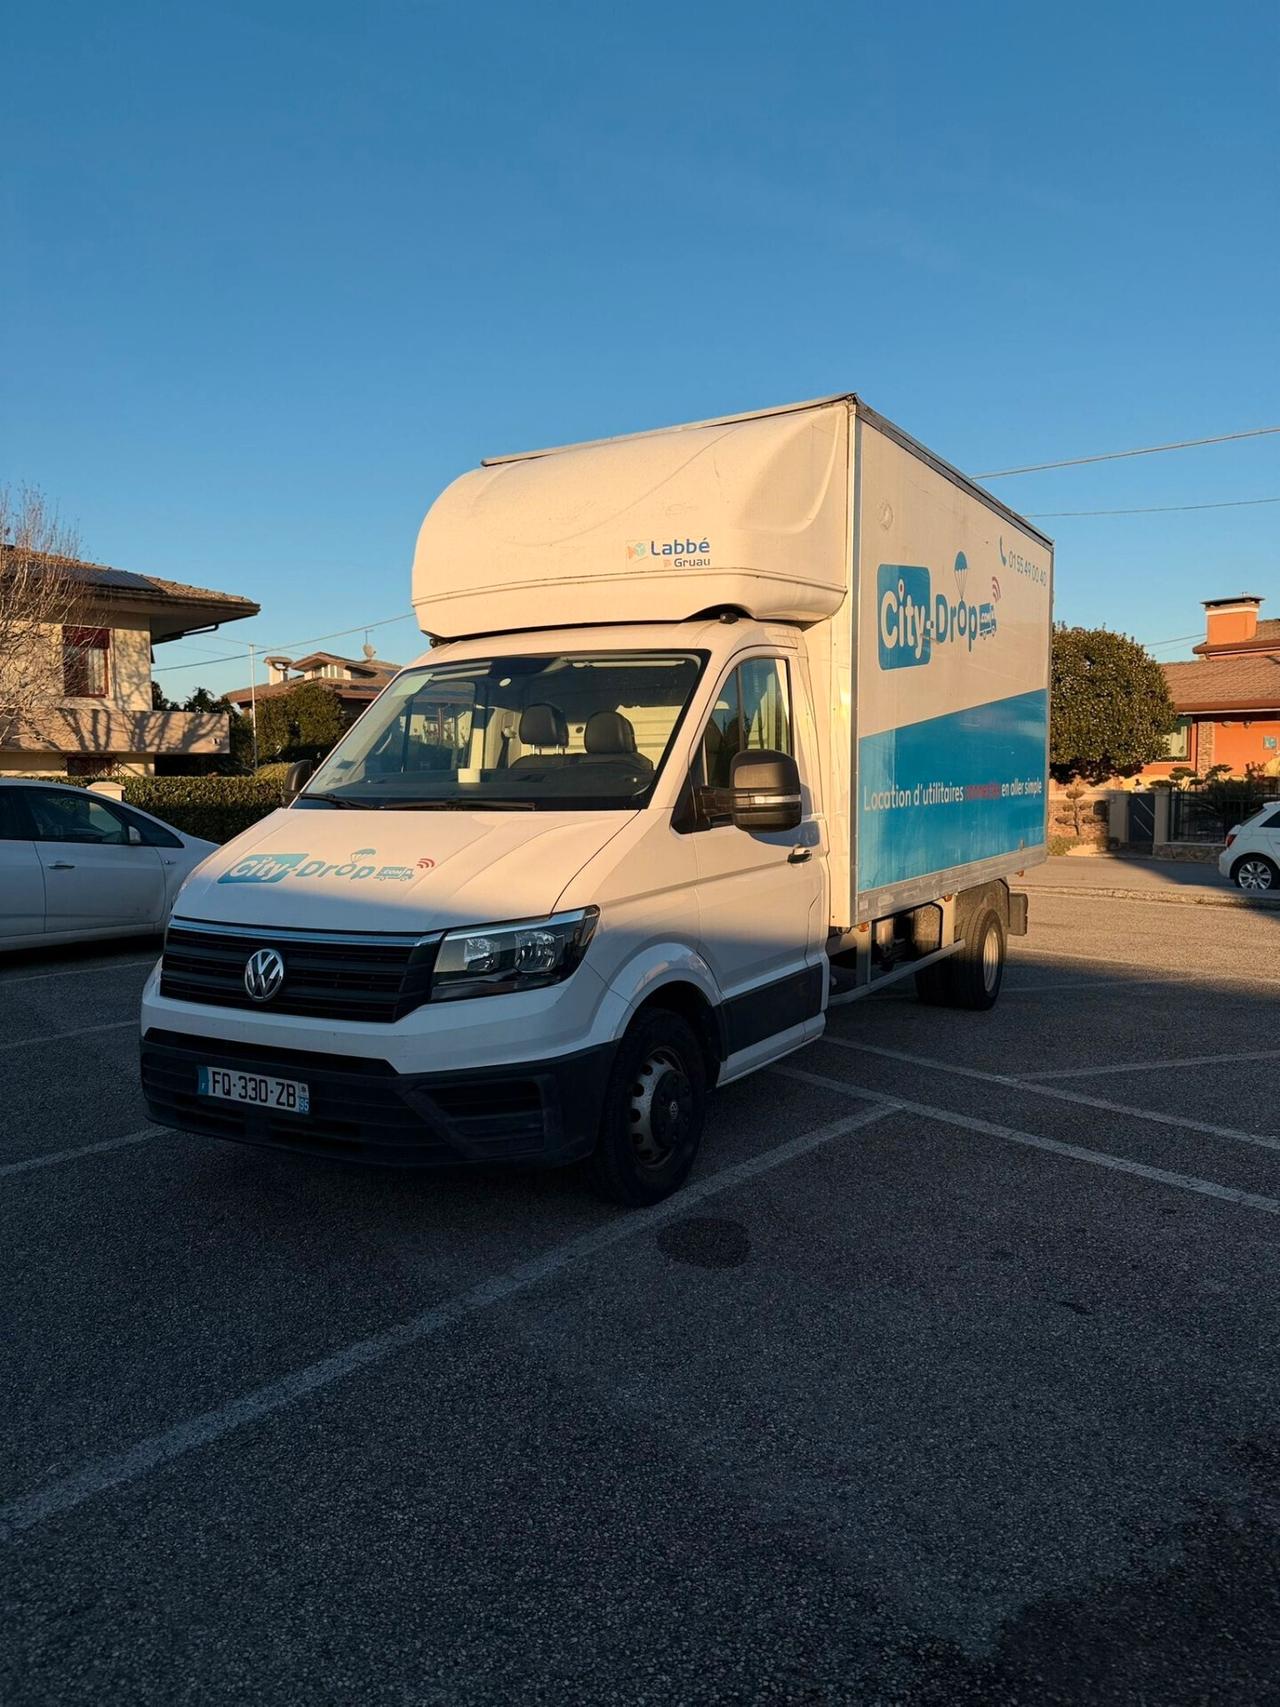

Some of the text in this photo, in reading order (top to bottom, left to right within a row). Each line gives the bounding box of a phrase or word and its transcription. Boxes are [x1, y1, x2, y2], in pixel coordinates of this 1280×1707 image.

[651, 537, 710, 556] Labbé
[674, 558, 711, 567] Gruau
[864, 784, 912, 811] Location
[913, 781, 964, 806] d'utilitaires
[1001, 783, 1009, 797] en
[1010, 777, 1024, 796] aller
[1024, 776, 1042, 798] simple
